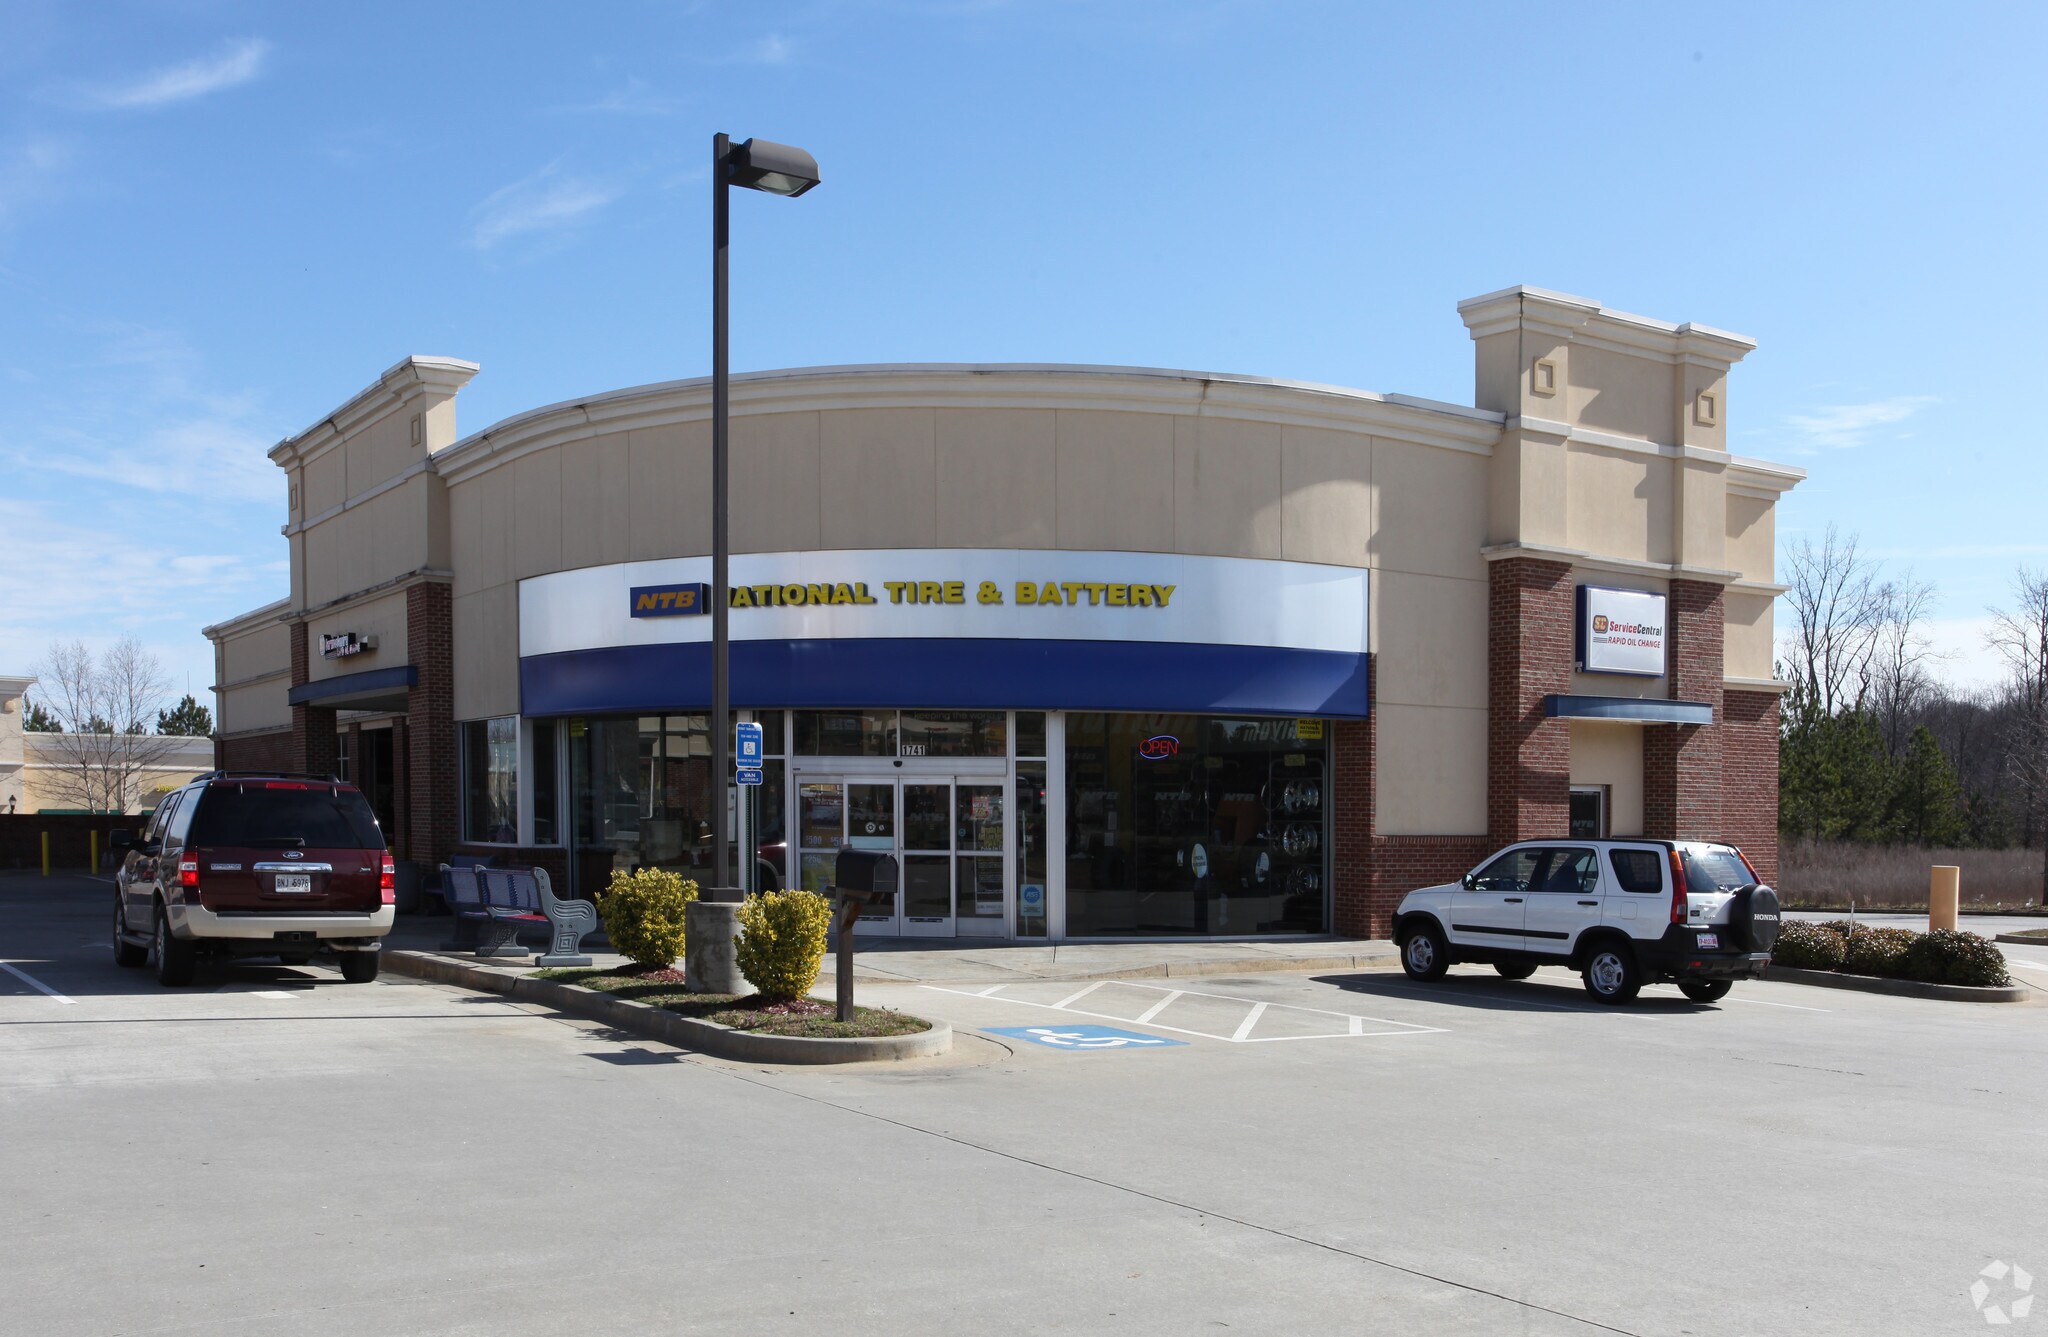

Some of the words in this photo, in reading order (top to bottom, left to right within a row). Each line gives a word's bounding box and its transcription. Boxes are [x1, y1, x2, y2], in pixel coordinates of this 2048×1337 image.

[636, 591, 696, 610] NTB
[728, 582, 876, 608] ATIONAL
[884, 581, 965, 604] TIRE
[976, 581, 1003, 604] &
[1015, 581, 1177, 607] BATTERY
[1609, 620, 1662, 636] ServiceCentral
[1608, 636, 1627, 646] RAPID
[1627, 637, 1637, 647] OIL
[1638, 639, 1661, 649] CHANGE
[914, 711, 950, 721] keeping
[952, 711, 968, 720] the
[902, 745, 925, 755] 1741
[1140, 738, 1178, 756] OPEN
[1224, 792, 1256, 801] NTB
[1754, 913, 1779, 921] HONDA
